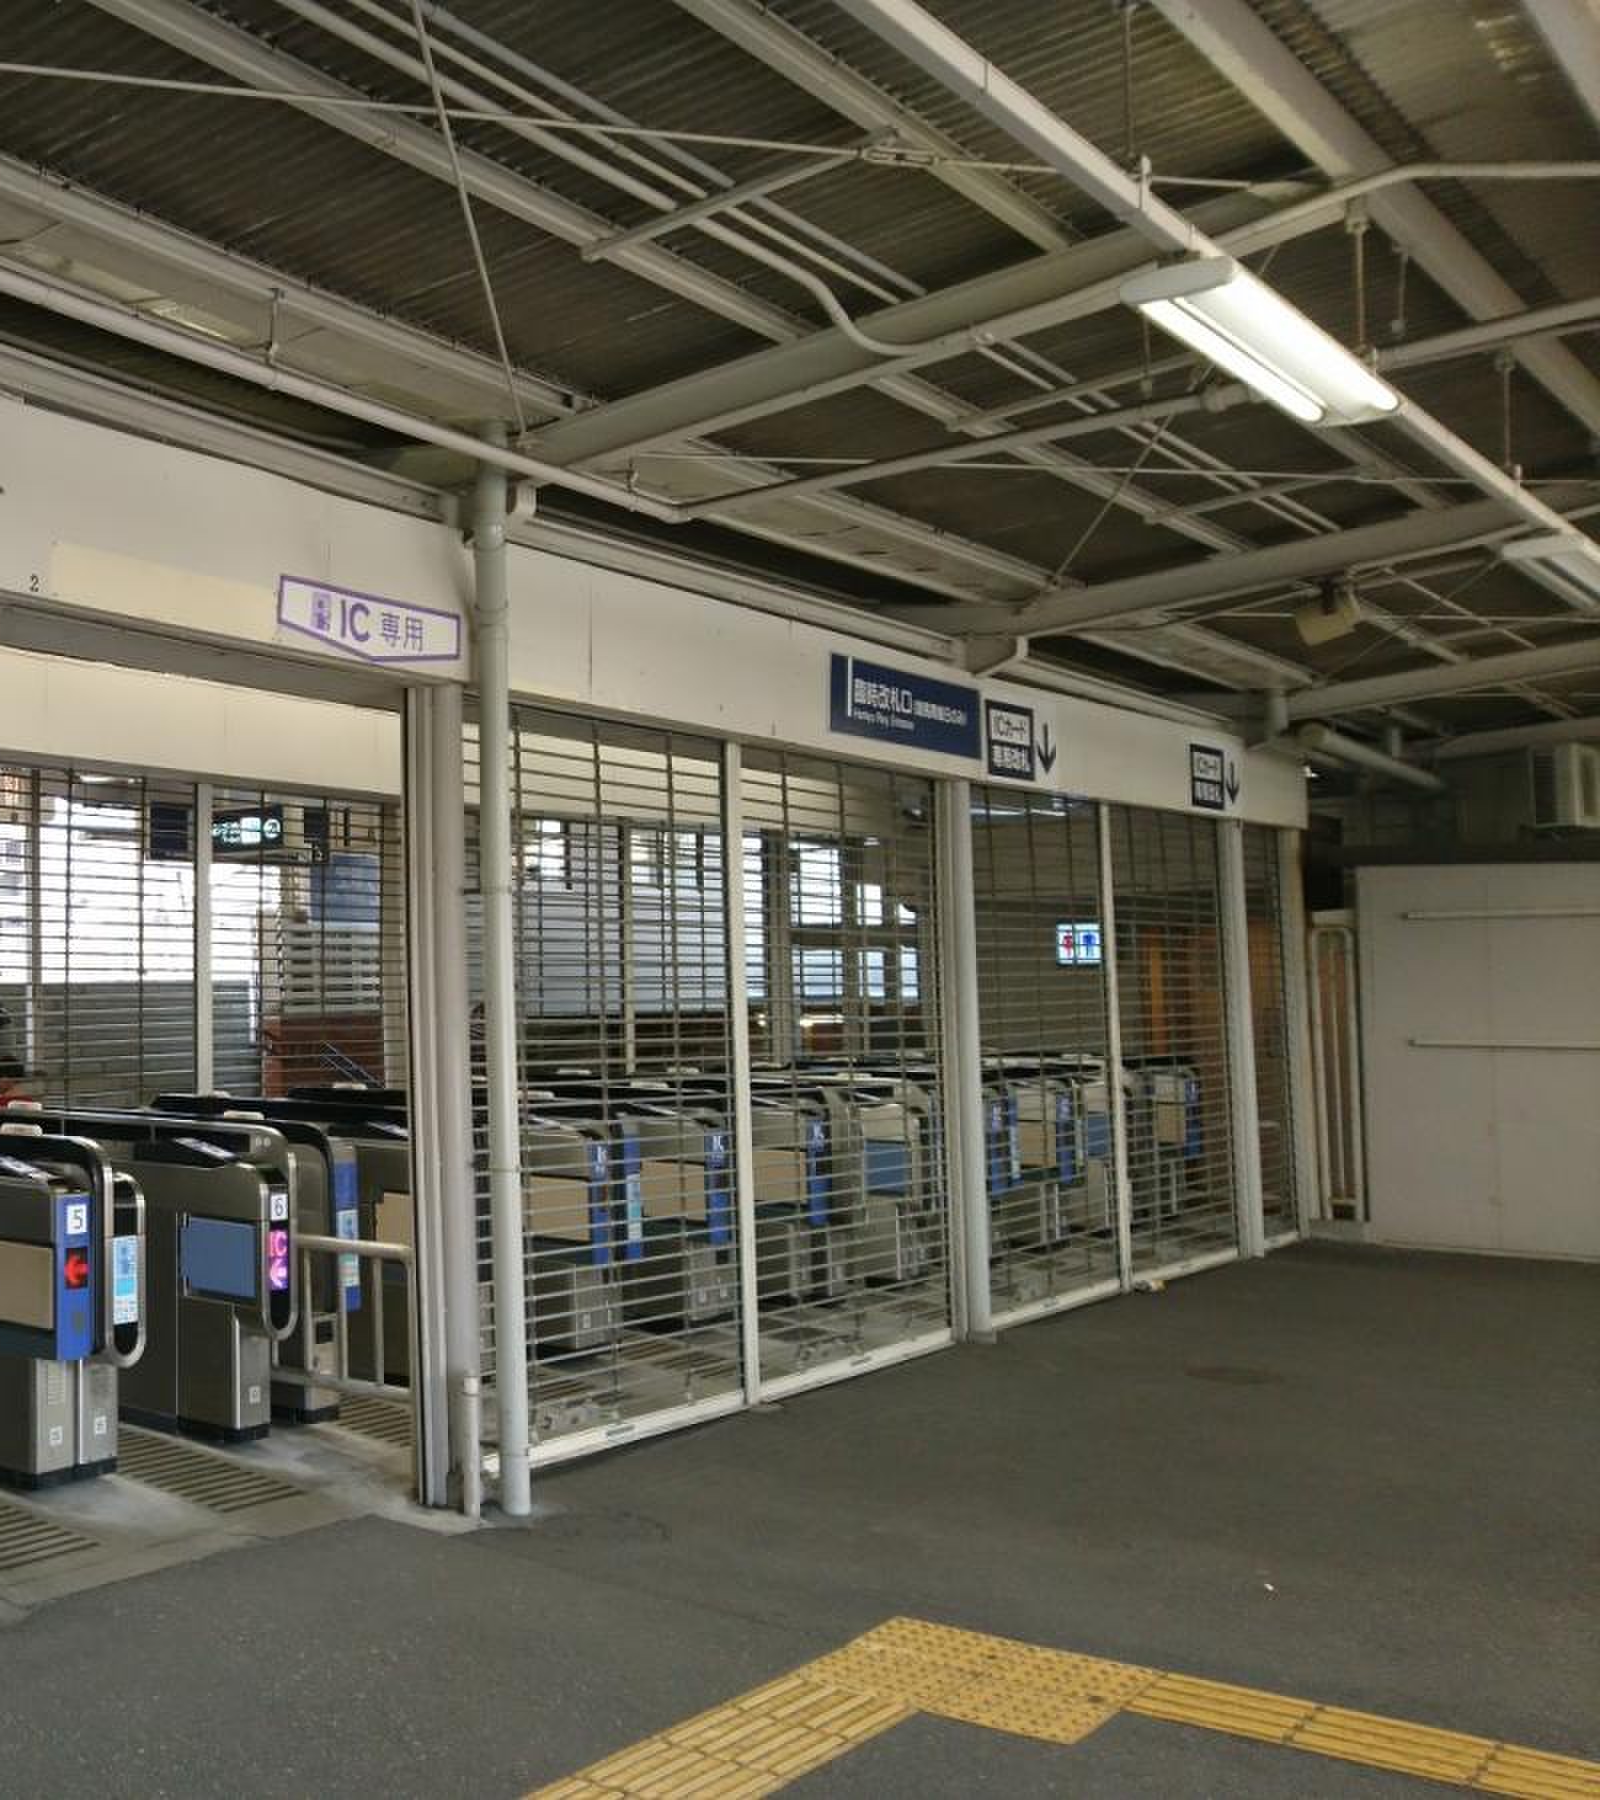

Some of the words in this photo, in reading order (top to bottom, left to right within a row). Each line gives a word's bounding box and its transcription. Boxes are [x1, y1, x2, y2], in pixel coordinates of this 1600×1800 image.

[29, 573, 40, 593] 2
[340, 599, 371, 642] IC
[380, 611, 424, 652] 専用
[274, 1197, 284, 1217] 6
[73, 1208, 84, 1230] 5
